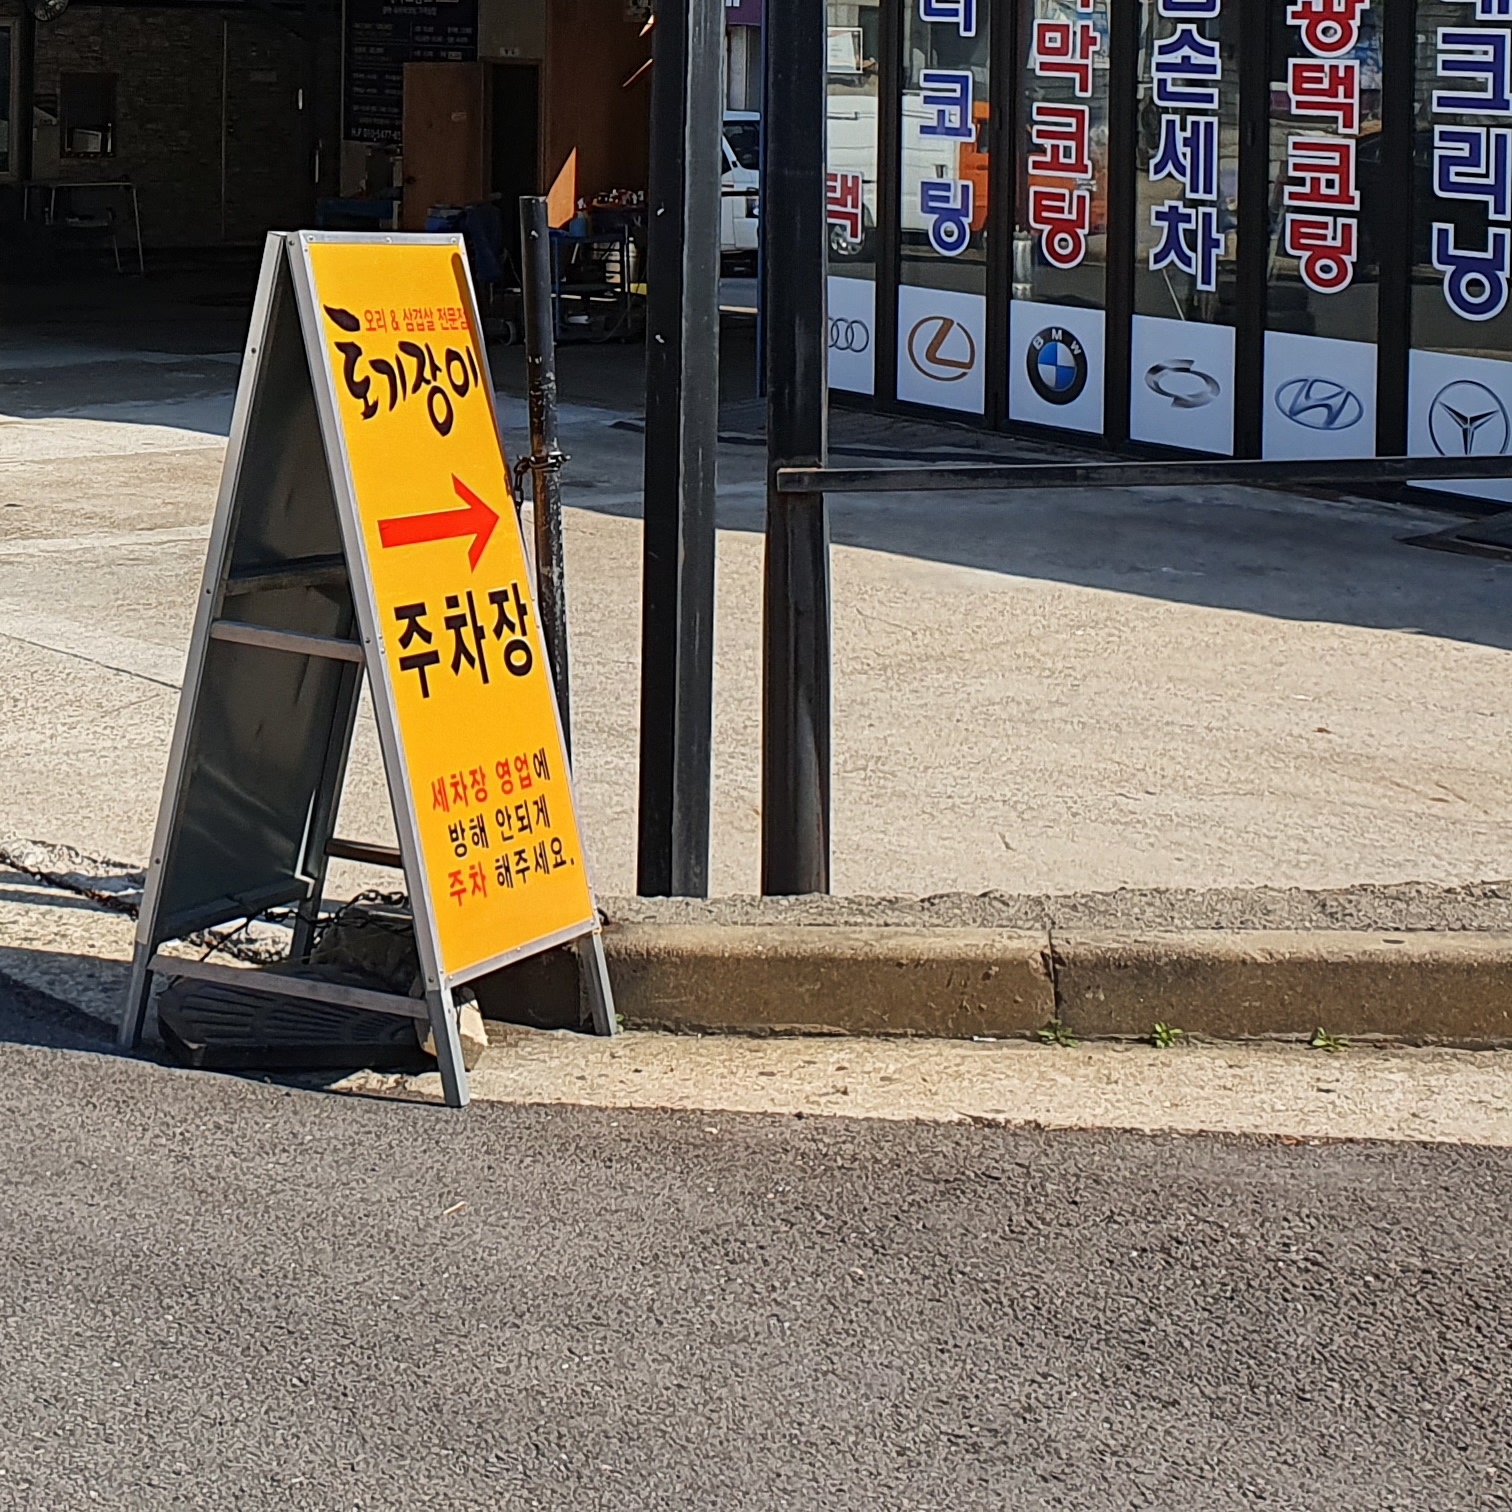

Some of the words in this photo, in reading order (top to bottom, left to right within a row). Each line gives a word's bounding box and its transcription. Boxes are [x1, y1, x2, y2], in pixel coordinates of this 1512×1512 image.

[364, 309, 387, 333] 오리
[390, 316, 401, 331] &
[402, 307, 437, 332] 삼겹살
[1033, 328, 1082, 355] BMW
[394, 583, 534, 699] 주차장
[431, 765, 489, 813] 세차장
[495, 747, 551, 796] 영업에
[448, 813, 489, 859] 방해
[495, 793, 551, 843] 안되게
[448, 861, 488, 907] 주차
[494, 836, 576, 889] 해주세요.
